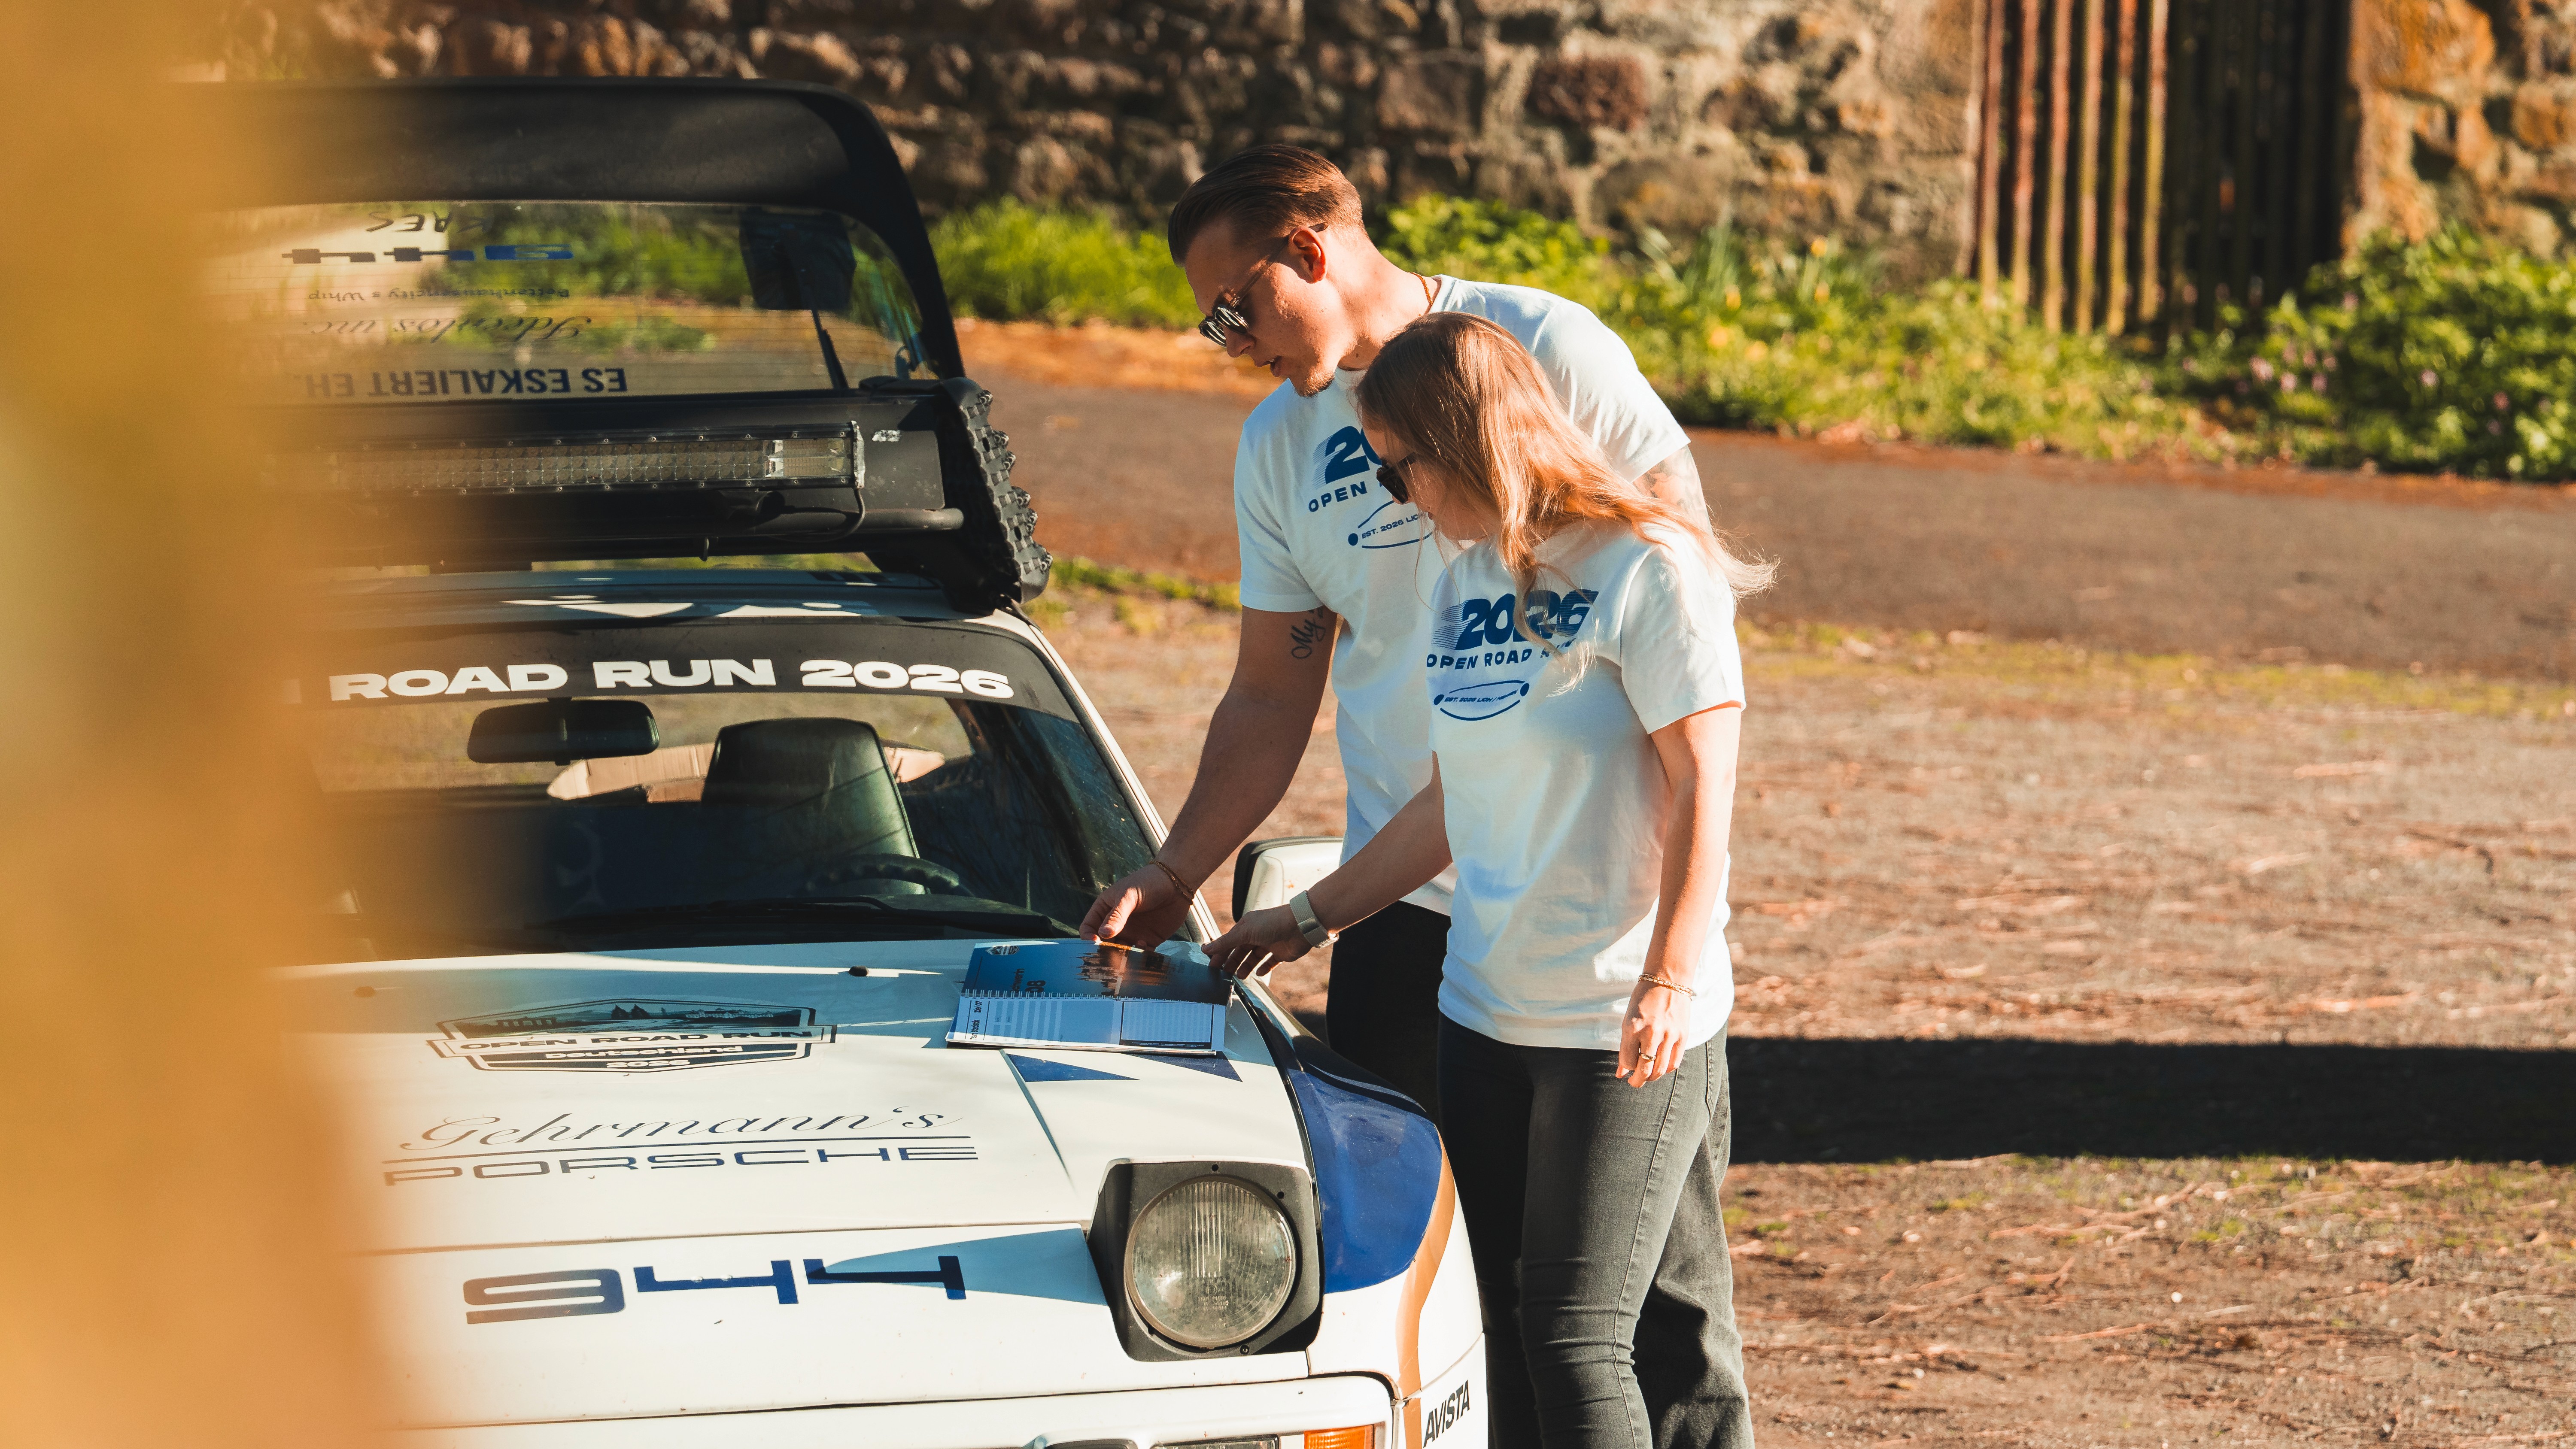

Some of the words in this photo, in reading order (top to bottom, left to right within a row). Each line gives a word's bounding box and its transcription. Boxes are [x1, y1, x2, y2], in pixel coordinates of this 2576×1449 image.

[369, 368, 571, 396] ESKALIERT
[583, 368, 628, 393] ES
[1308, 481, 1367, 512] OPEN
[1361, 528, 1379, 539] EST.
[1380, 519, 1404, 532] 2026
[1405, 514, 1423, 523] LIC
[1431, 589, 1599, 650] 2026
[1426, 654, 1478, 670] OPEN
[1484, 649, 1532, 667] ROAD
[329, 663, 568, 701] ROAD
[593, 658, 776, 688] RUN
[800, 660, 1015, 698] 2026
[460, 1039, 577, 1049] OPEN
[591, 1034, 708, 1043] ROAD
[545, 1046, 743, 1059] Deutschland
[606, 1059, 690, 1068] 2026
[399, 1106, 964, 1151] Gehrmann's
[383, 1146, 978, 1185] PORSCHE
[463, 1255, 967, 1324] 944
[1423, 1379, 1470, 1448] AVISTA
